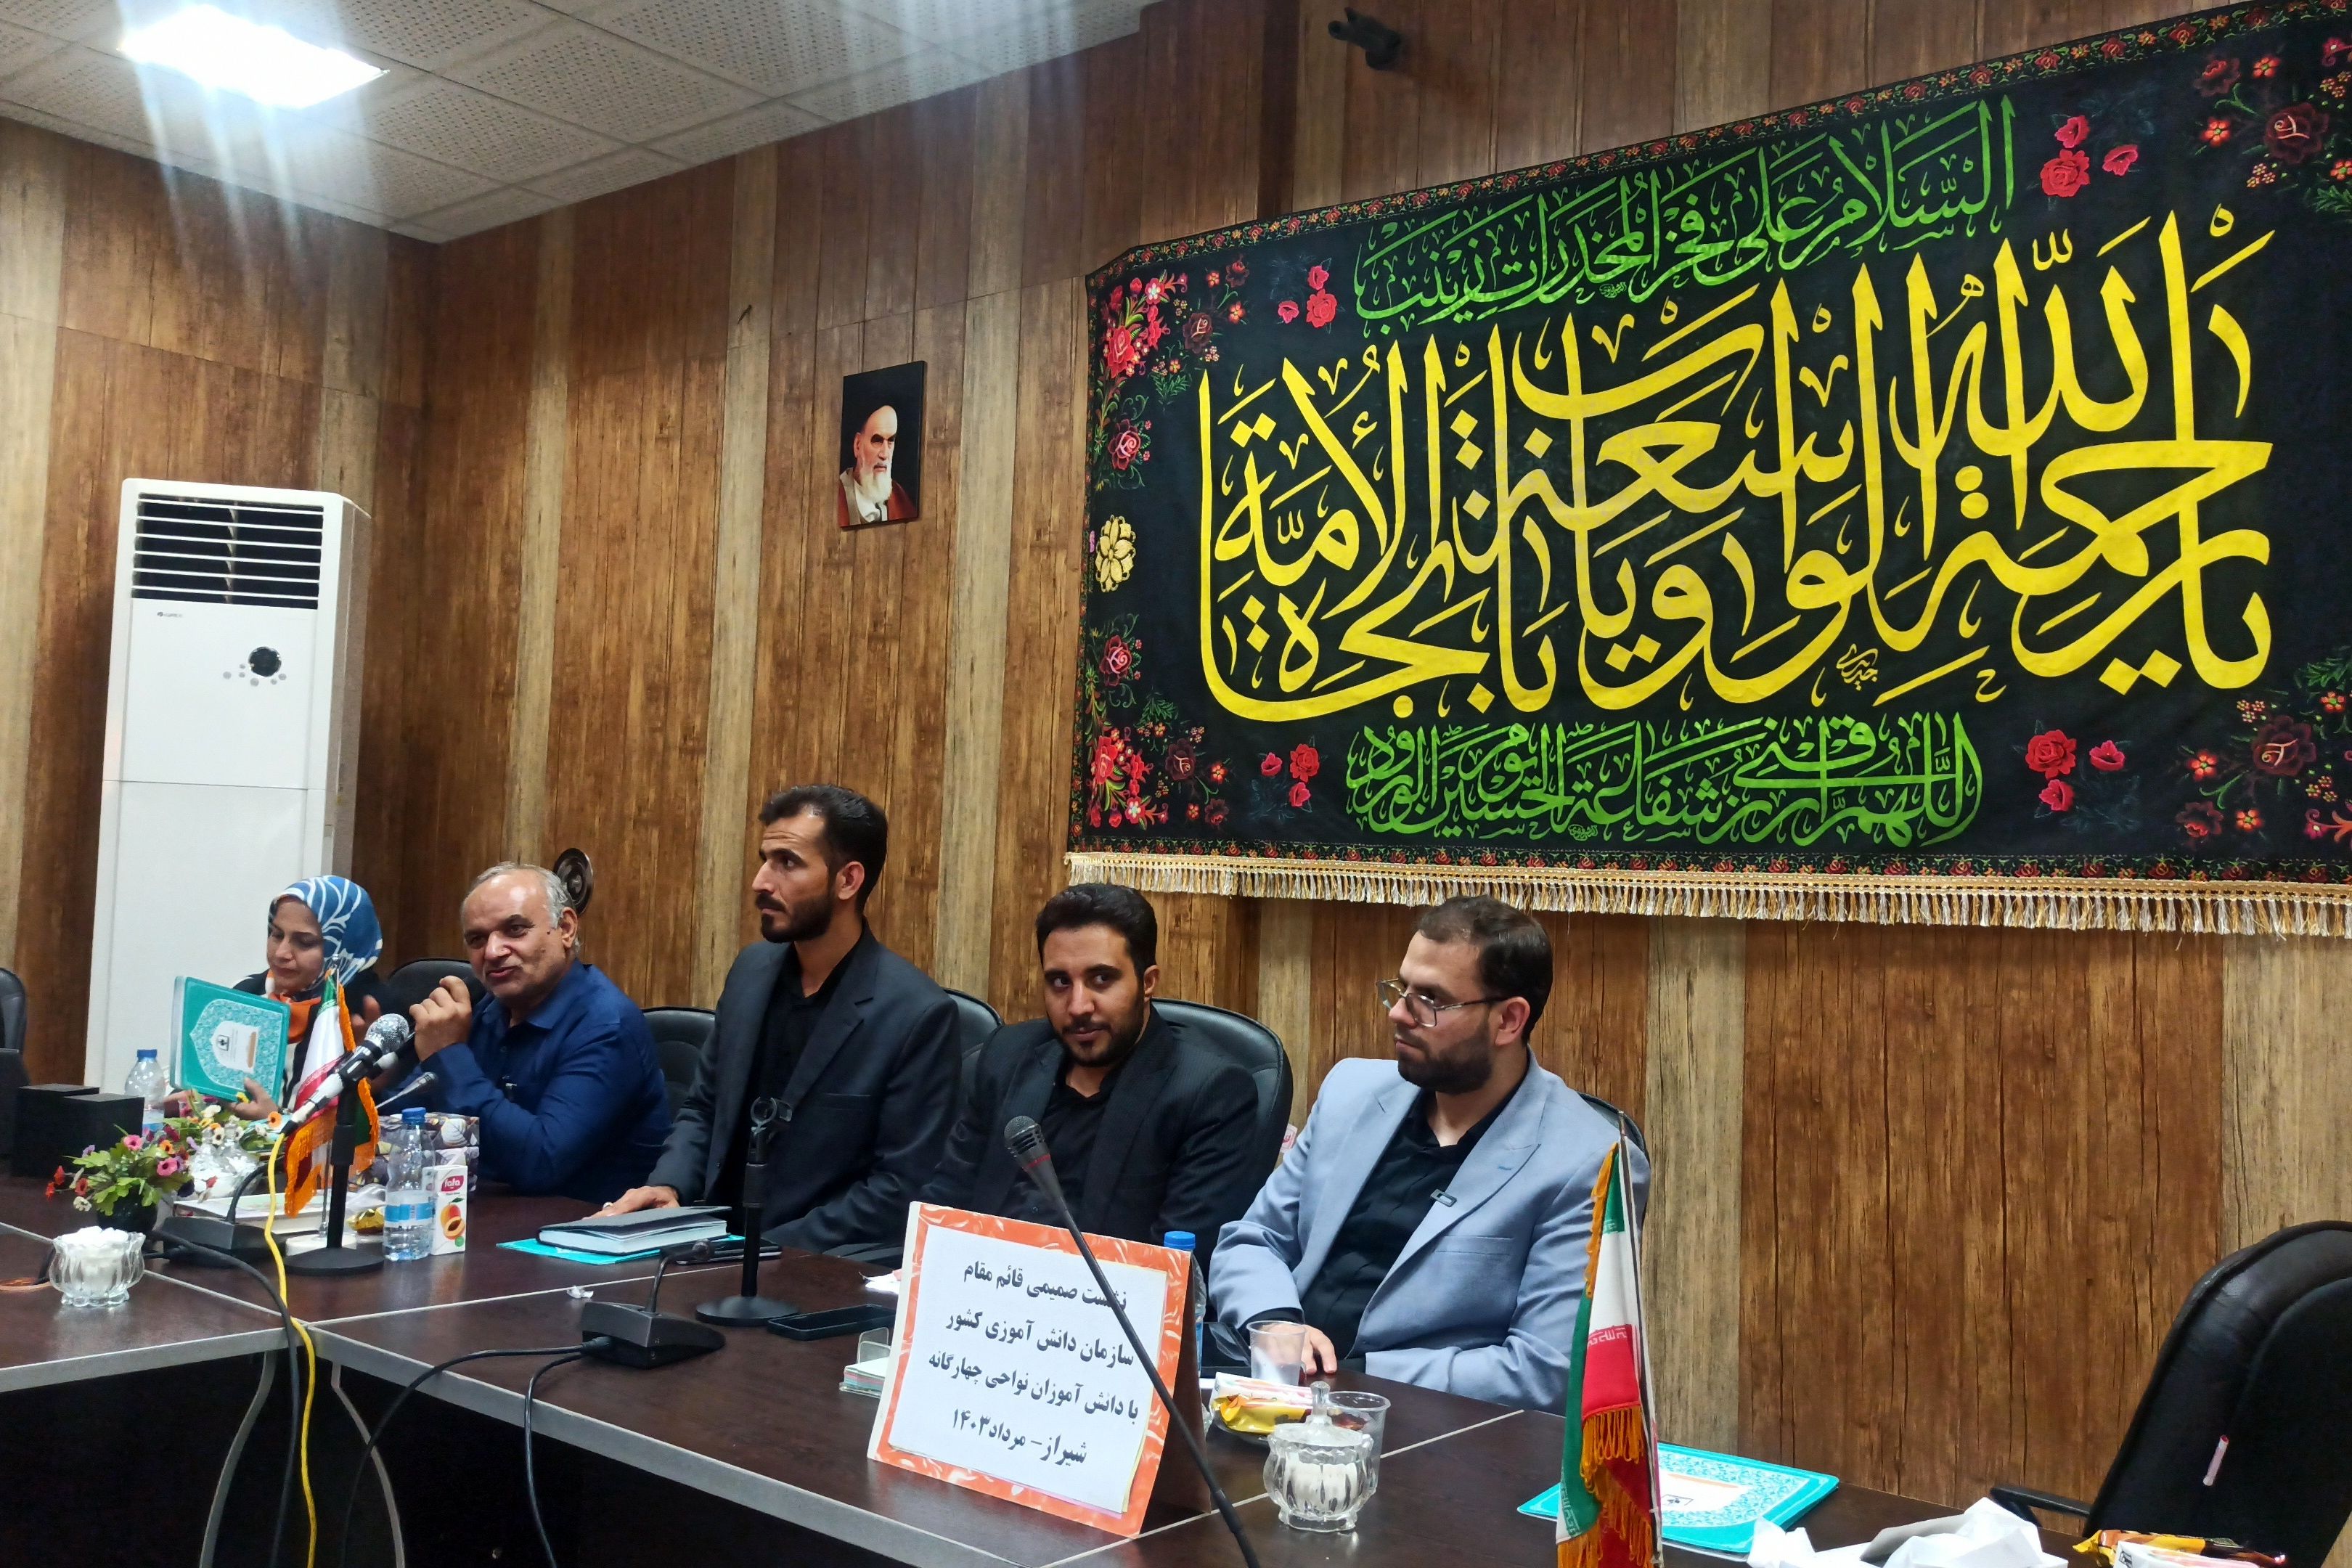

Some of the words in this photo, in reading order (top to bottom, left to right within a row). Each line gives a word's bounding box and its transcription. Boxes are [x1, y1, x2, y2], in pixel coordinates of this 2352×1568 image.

[963, 1260, 993, 1283] مقام
[997, 1265, 1023, 1289] قائم
[1026, 1283, 1078, 1301] صمیمی
[945, 1308, 983, 1331] کشور
[985, 1319, 1035, 1344] آموزی
[1037, 1328, 1077, 1352] دانش
[1079, 1338, 1134, 1368] سازمان
[985, 1370, 1029, 1395] نواحی
[1030, 1378, 1084, 1407] آموزان
[1084, 1391, 1124, 1414] دانش
[1127, 1399, 1139, 1424] با
